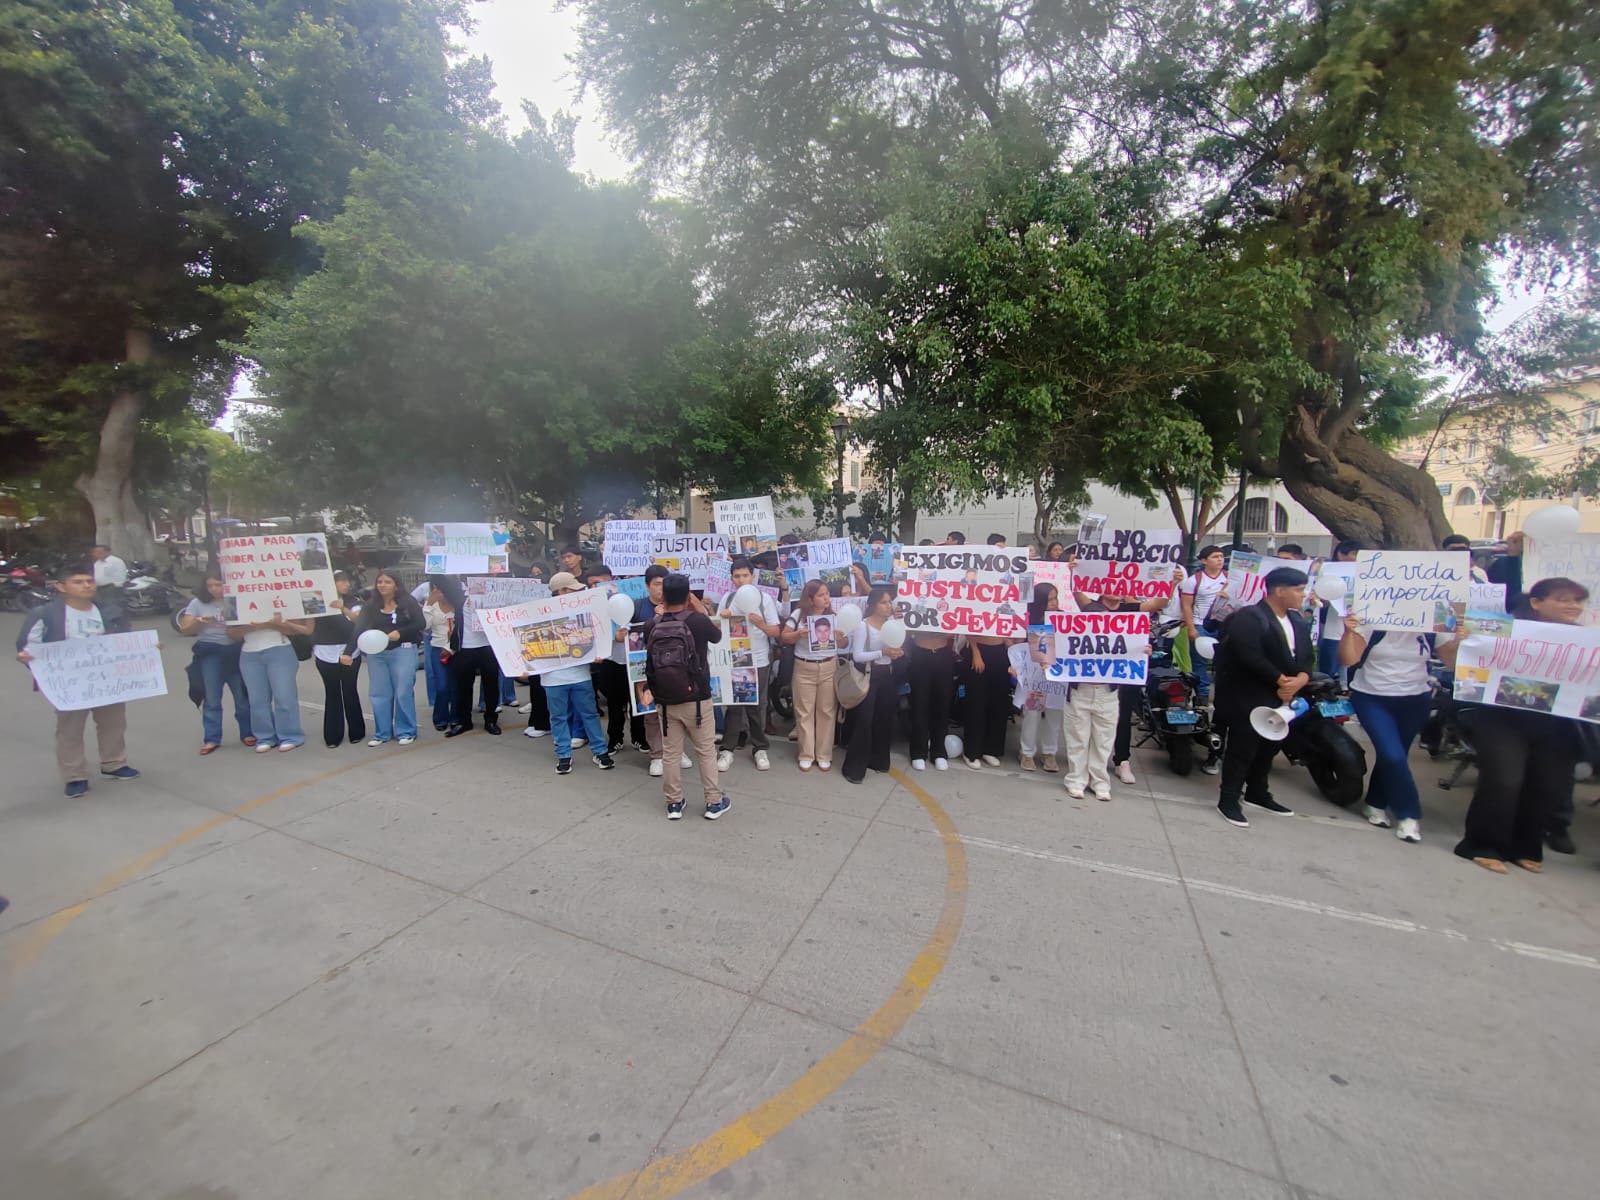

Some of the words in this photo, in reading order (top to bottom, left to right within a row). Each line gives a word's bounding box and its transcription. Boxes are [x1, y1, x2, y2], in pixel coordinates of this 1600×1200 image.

[263, 536, 295, 545] PARA
[655, 537, 726, 553] JUSTICIA
[1114, 530, 1146, 548] NO
[261, 553, 275, 562] LA
[1076, 542, 1184, 563] FALLECIO
[251, 569, 266, 578] LA
[274, 567, 295, 577] LEY
[902, 552, 1028, 574] EXIGIMOS
[1107, 561, 1139, 580] LO
[1360, 552, 1395, 580] La
[1399, 560, 1463, 580] vida
[237, 580, 314, 593] DEFENDERLO
[899, 579, 1020, 603] JUSTICIA
[1073, 575, 1174, 599] MATARON
[249, 602, 258, 610] A
[898, 601, 939, 629] POR
[941, 607, 1030, 636] STEVEN
[1068, 634, 1128, 655] PARA
[1049, 658, 1145, 680] STEVEN
